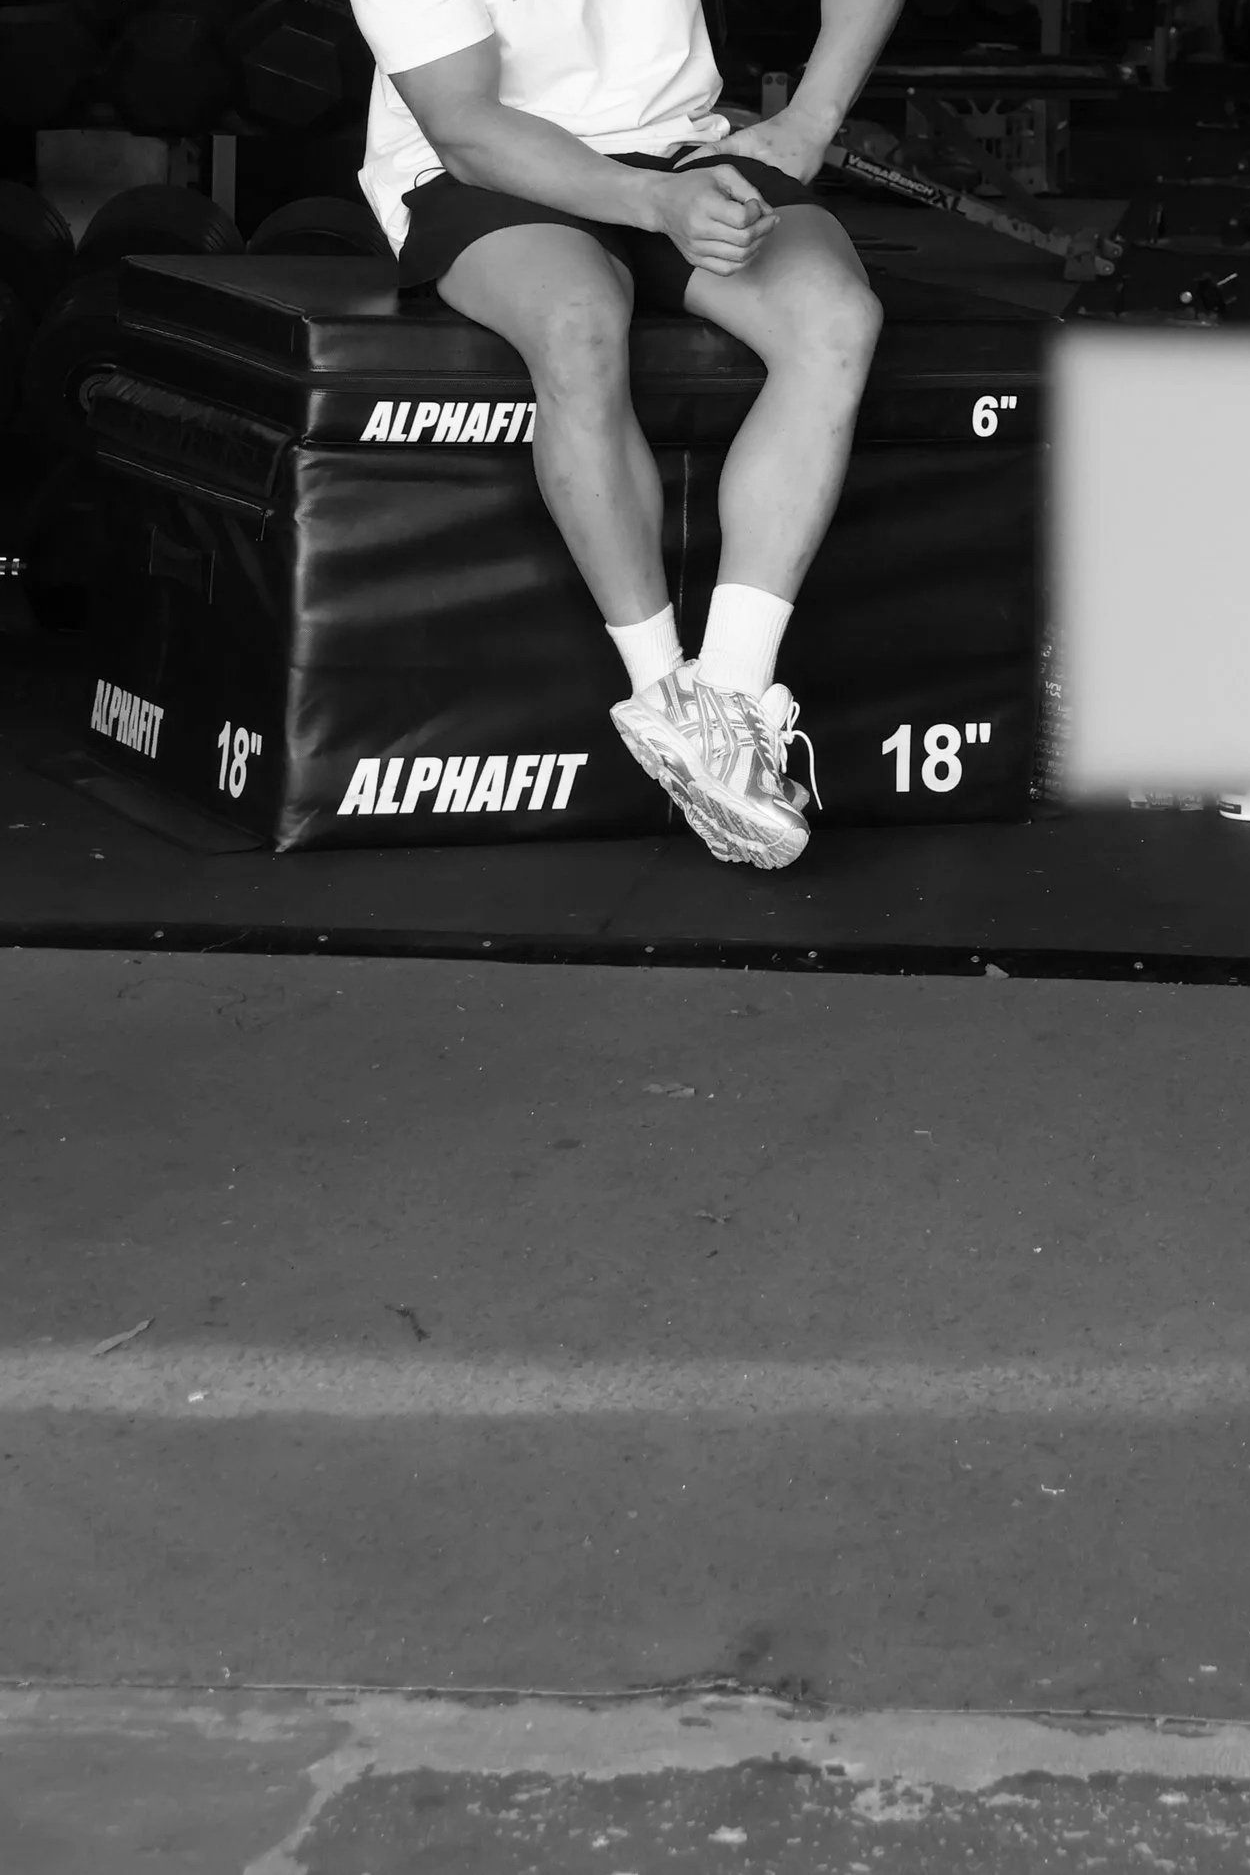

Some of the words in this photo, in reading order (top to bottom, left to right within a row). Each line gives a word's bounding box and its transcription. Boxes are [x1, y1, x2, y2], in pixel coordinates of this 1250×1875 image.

[972, 395, 1017, 437] 6"
[91, 678, 164, 759] ALPHAFIT
[217, 720, 262, 798] 18"
[337, 753, 589, 815] ALPHAFIT
[882, 722, 991, 792] 18"
